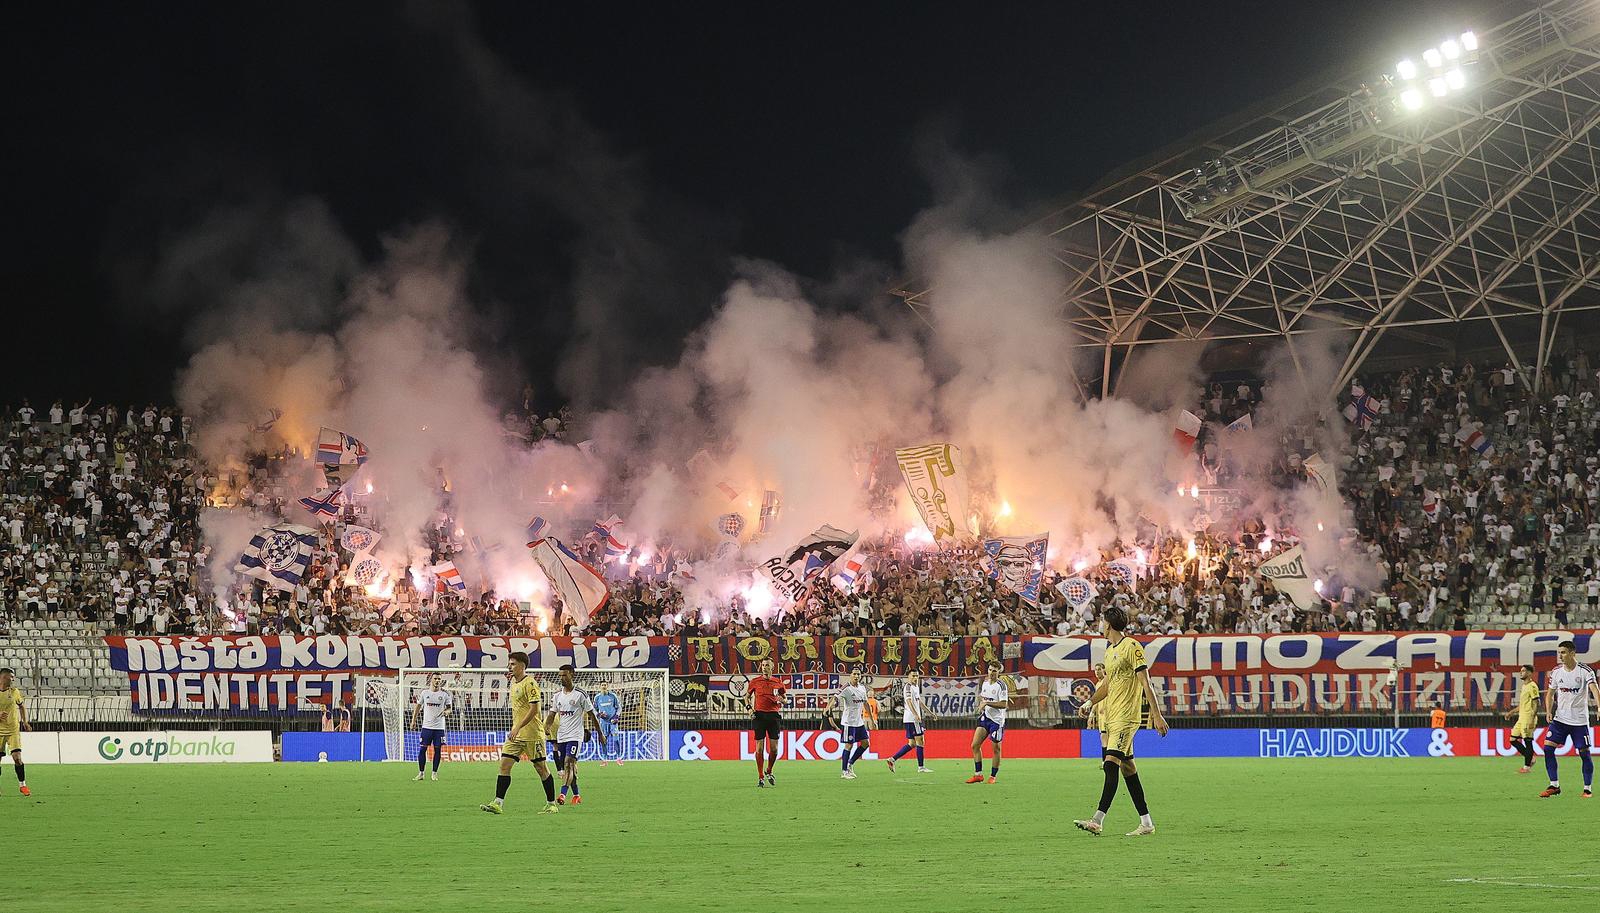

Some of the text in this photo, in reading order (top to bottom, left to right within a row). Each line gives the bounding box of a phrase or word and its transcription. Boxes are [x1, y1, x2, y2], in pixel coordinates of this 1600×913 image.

[687, 636, 997, 666] TORCIDA
[1336, 633, 1452, 669] ZA
[137, 672, 350, 711] IDENTITET
[1150, 671, 1394, 712] HAJDUK
[1259, 728, 1410, 758] HAJDUK
